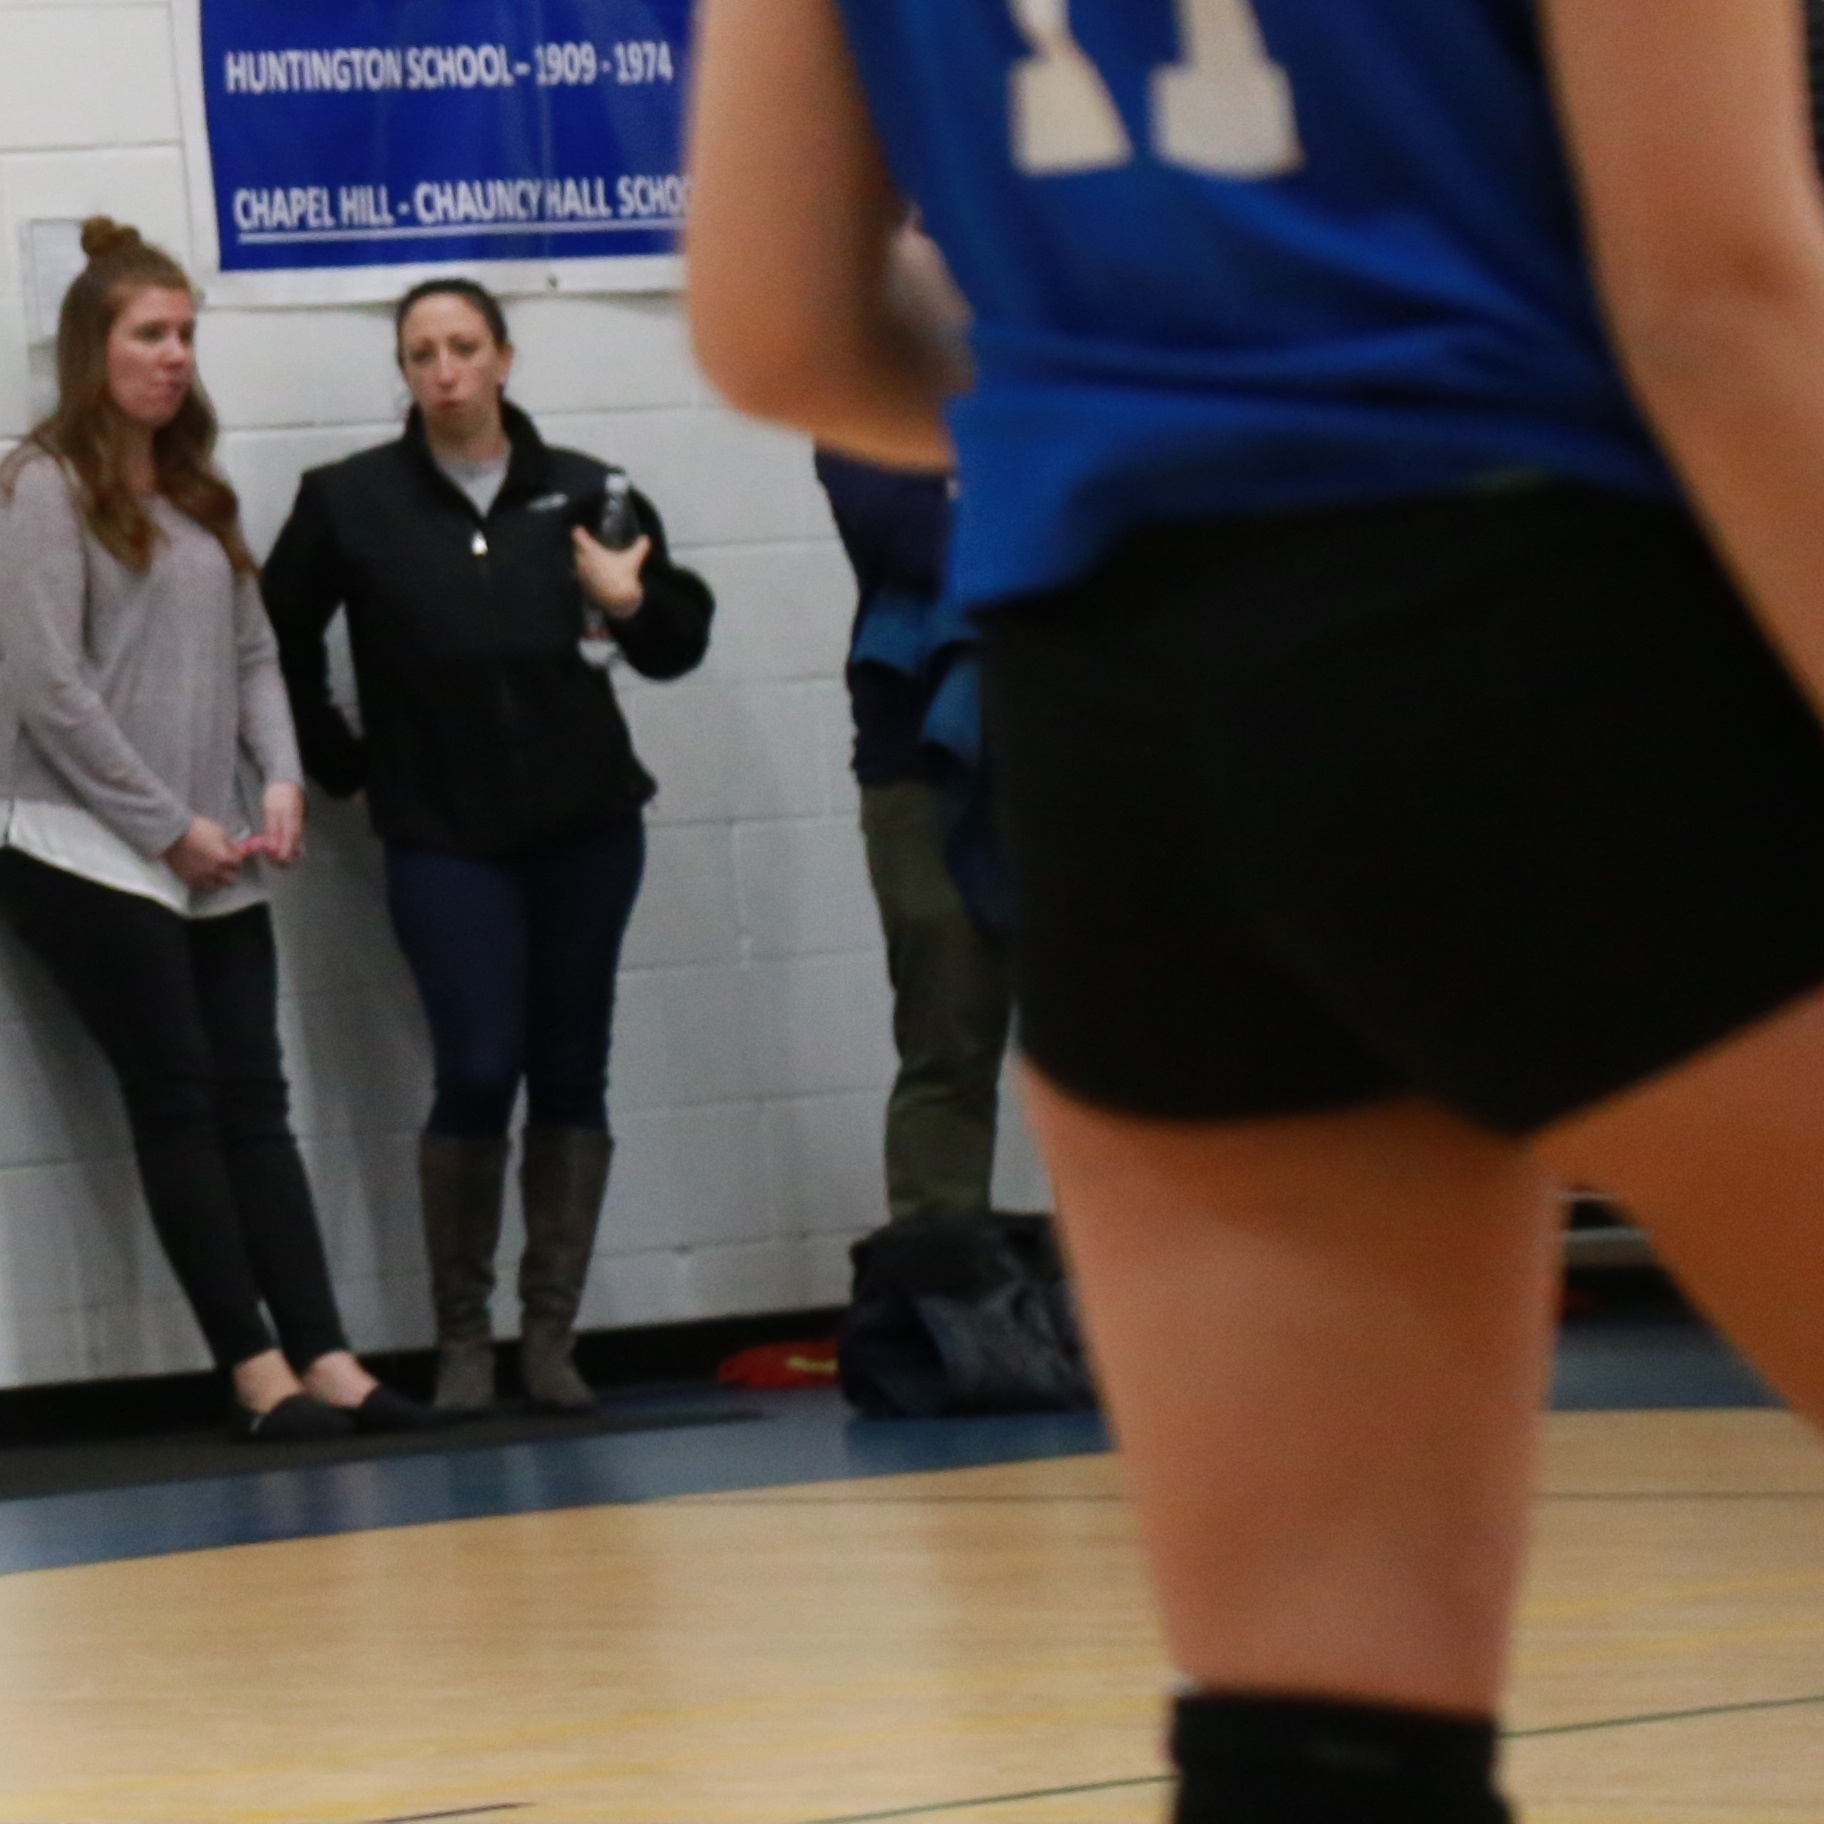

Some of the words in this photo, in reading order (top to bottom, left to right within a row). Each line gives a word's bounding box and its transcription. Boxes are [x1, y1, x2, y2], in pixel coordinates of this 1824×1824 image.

[224, 48, 402, 93] HUNTINGTON
[406, 45, 514, 89] SCHOOL
[534, 42, 597, 86] 1909
[614, 41, 674, 84] 1974
[233, 187, 335, 230] CHAPEL
[340, 184, 395, 226] HILL
[414, 180, 542, 224] CHAUNCY
[547, 177, 612, 218] HALL
